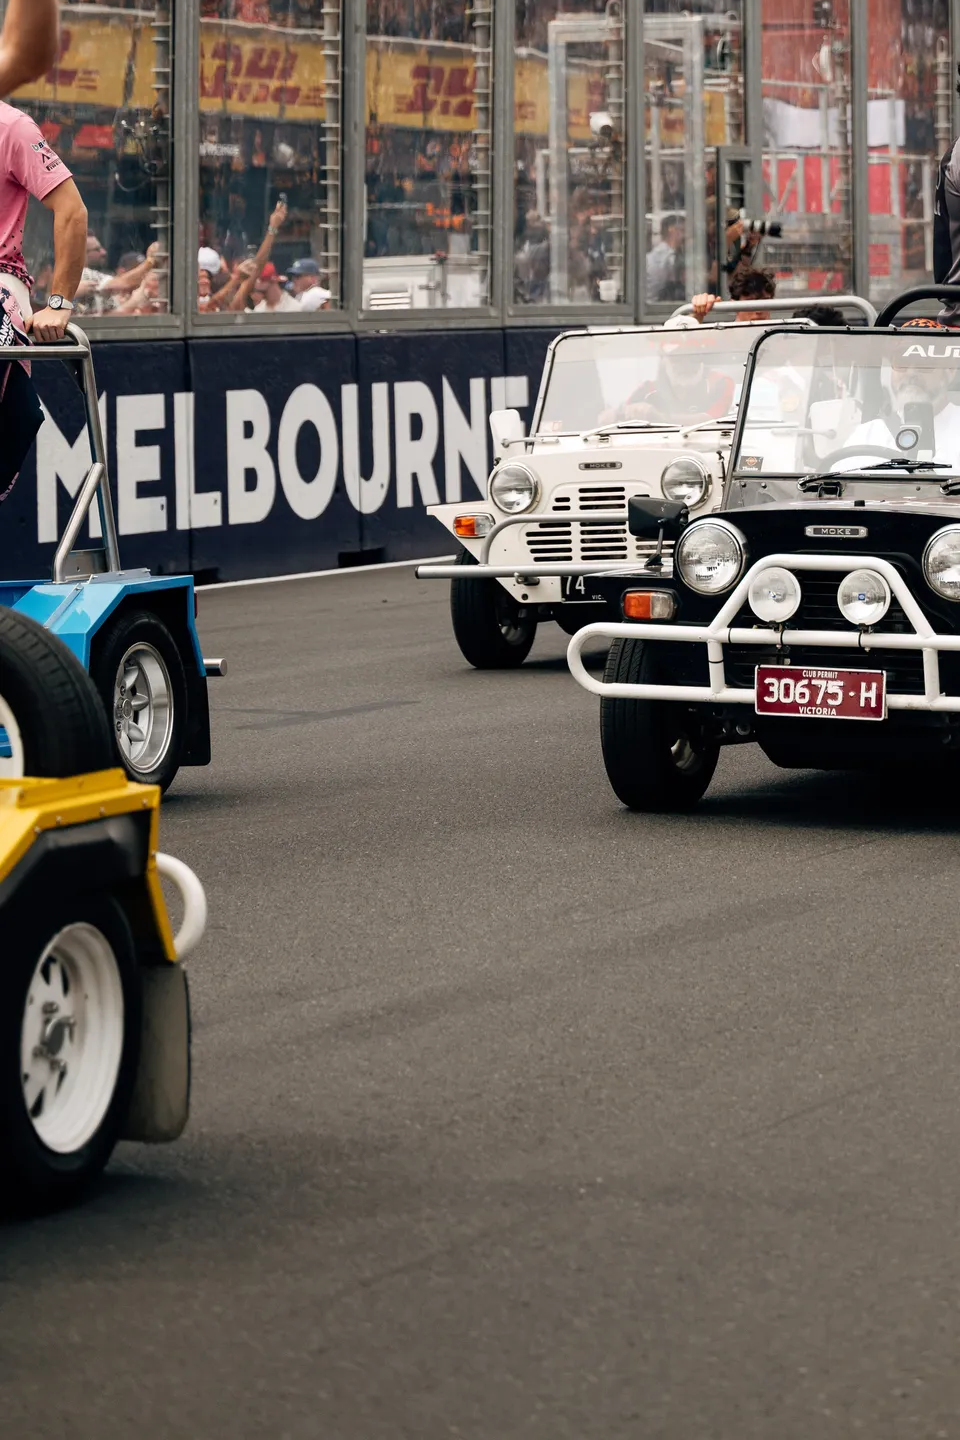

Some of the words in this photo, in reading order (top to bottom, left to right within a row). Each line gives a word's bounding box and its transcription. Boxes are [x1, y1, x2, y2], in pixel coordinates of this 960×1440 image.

[821, 527, 852, 535] MOKE
[802, 669, 817, 678] CLUB
[817, 671, 838, 679] PERMIT
[799, 706, 837, 716] VICTORIA
